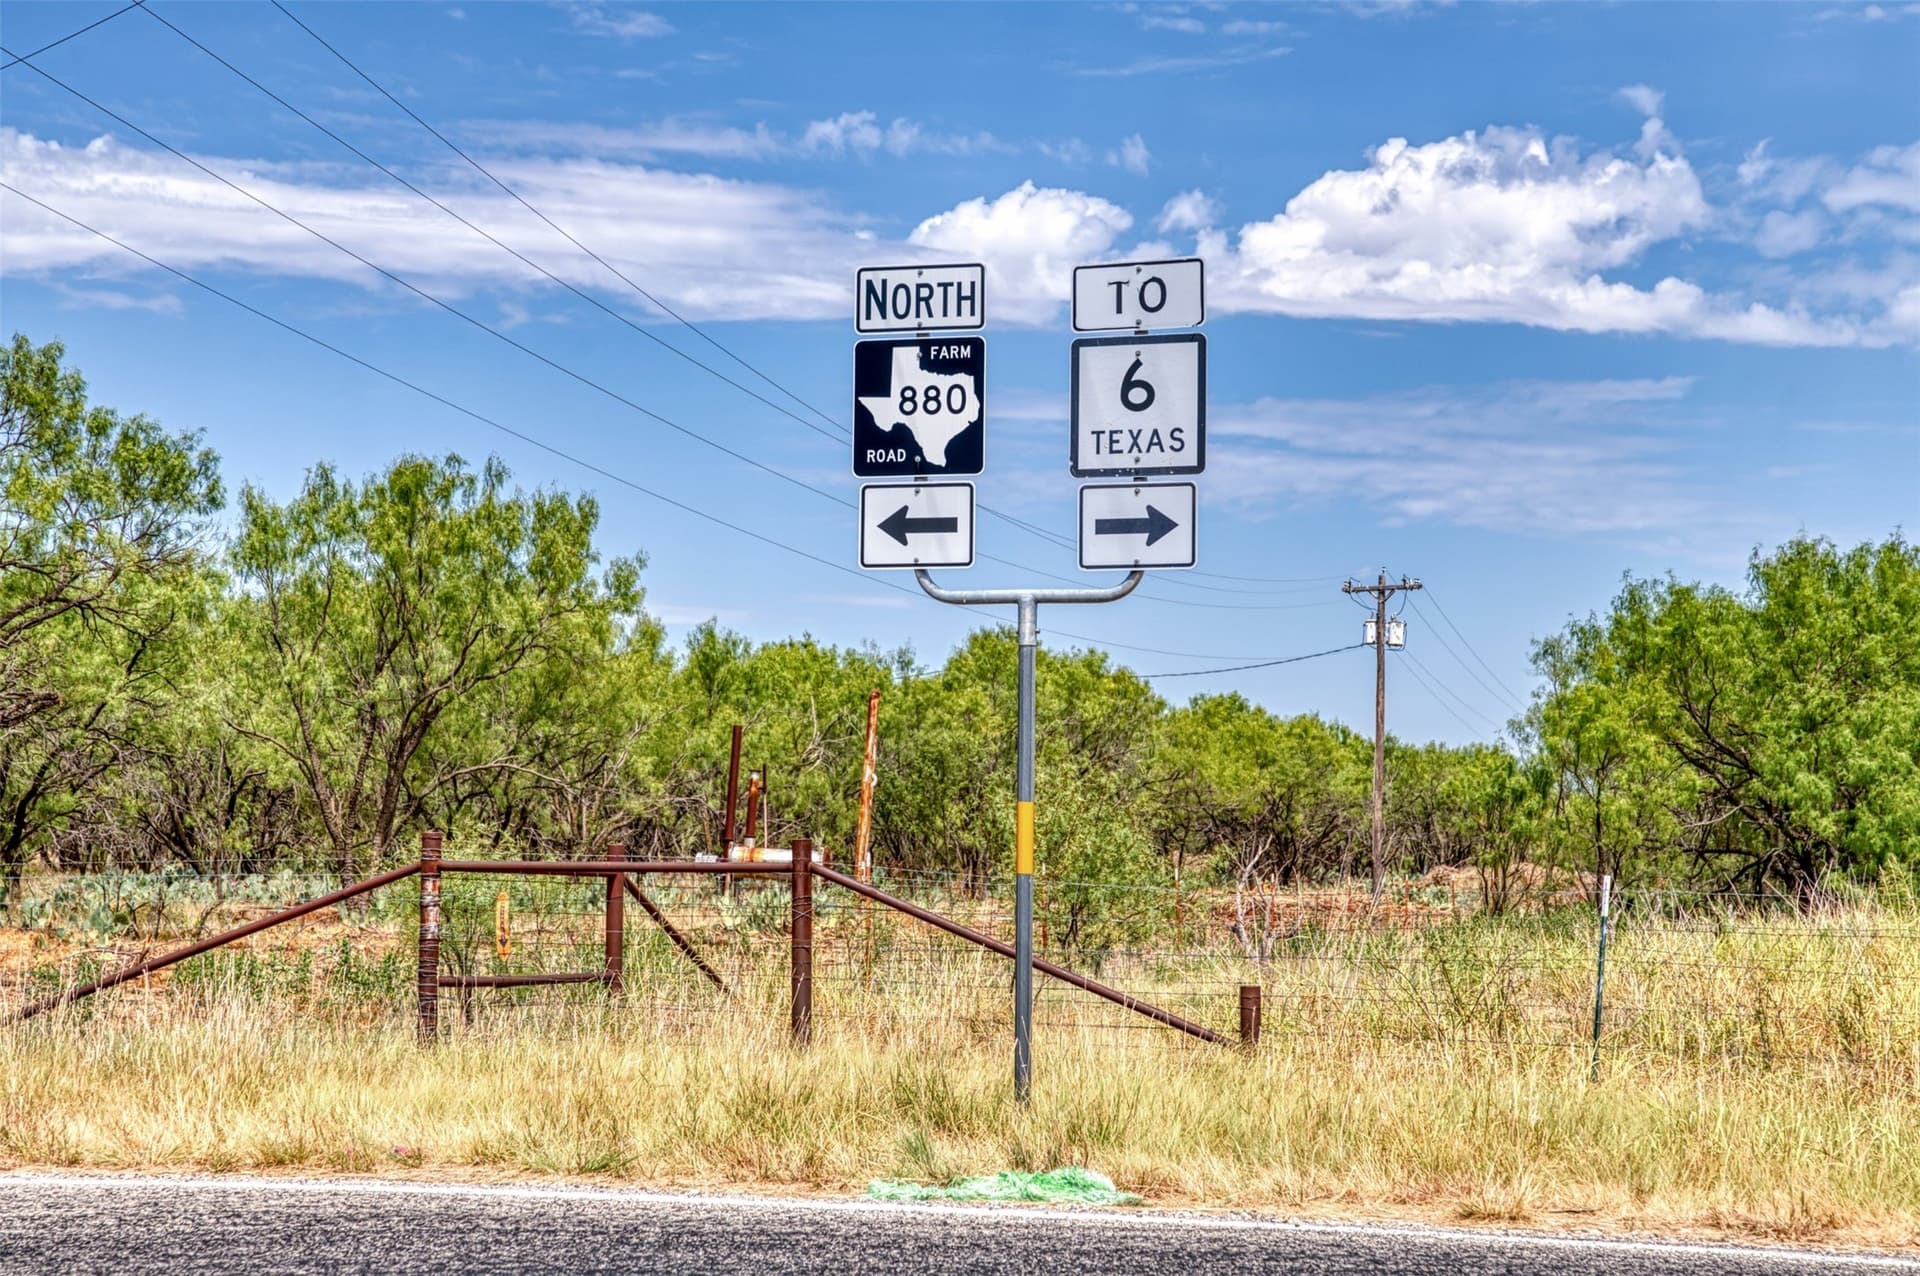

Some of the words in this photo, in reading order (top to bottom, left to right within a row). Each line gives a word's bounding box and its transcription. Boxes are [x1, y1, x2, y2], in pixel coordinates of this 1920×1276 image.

[865, 278, 976, 321] NORTH
[1107, 276, 1167, 314] TO
[930, 345, 971, 360] FARM
[899, 383, 967, 416] 880
[1120, 358, 1156, 412] 6
[866, 449, 907, 463] ROAD
[1091, 427, 1185, 455] TEXAS
